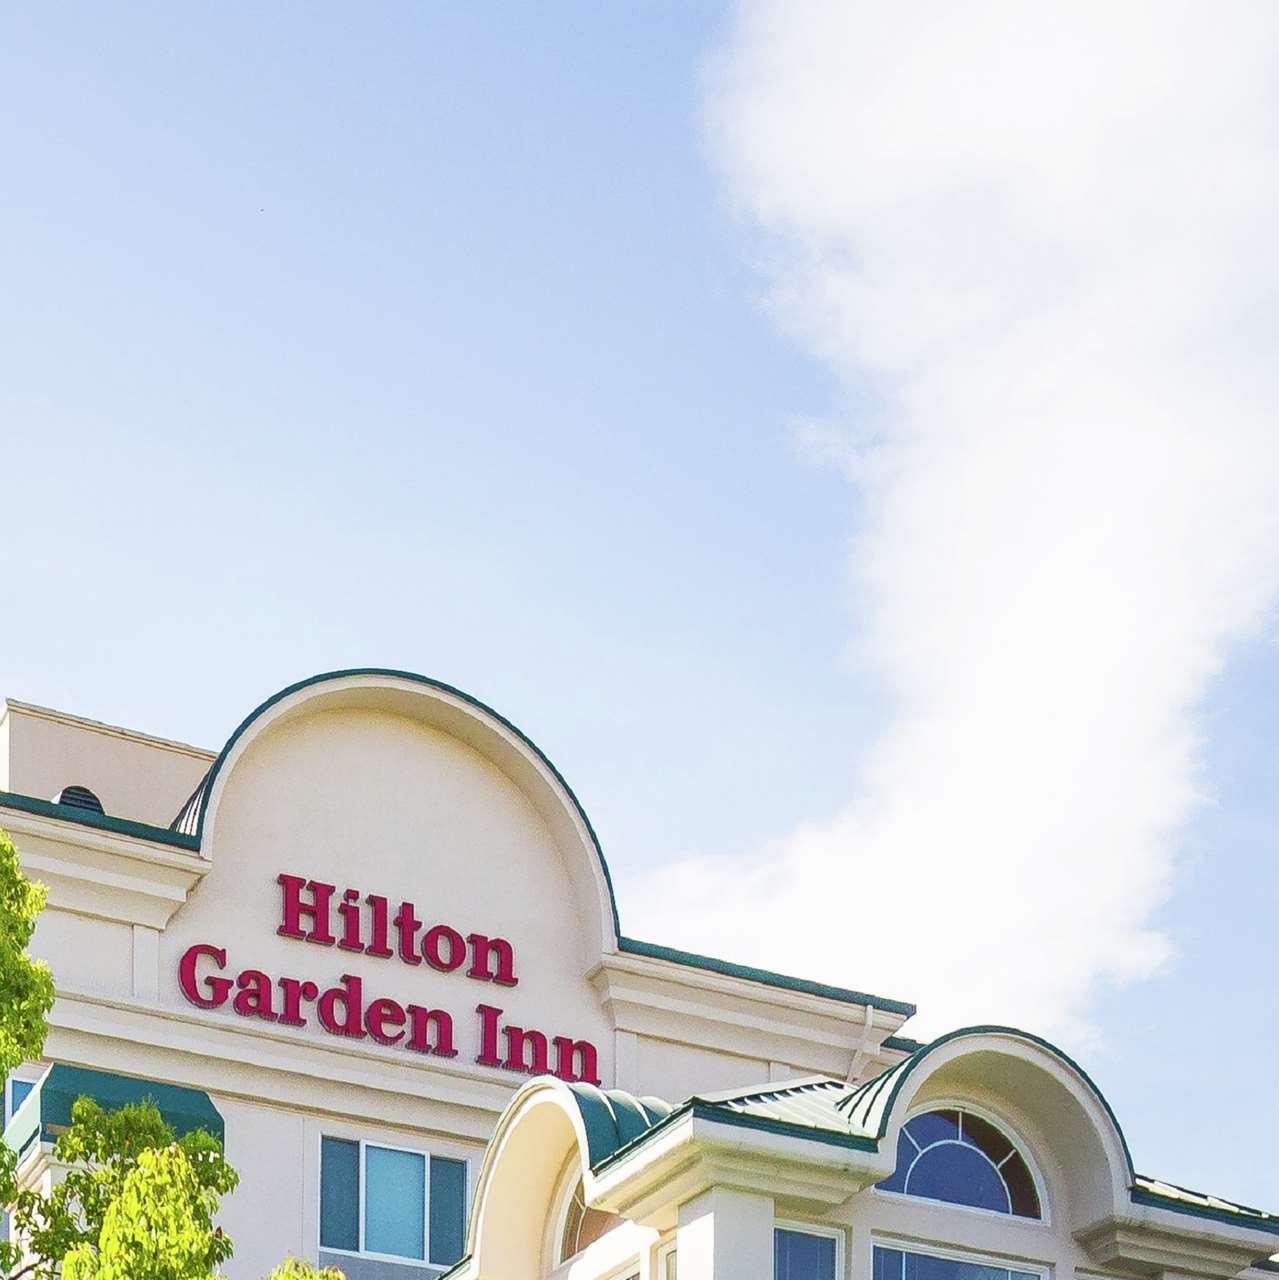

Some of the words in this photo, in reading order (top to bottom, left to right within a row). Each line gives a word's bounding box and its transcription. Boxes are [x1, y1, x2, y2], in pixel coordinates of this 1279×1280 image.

[276, 873, 518, 987] Hilton
[178, 943, 459, 1058] Garden
[475, 1003, 601, 1086] Inn
